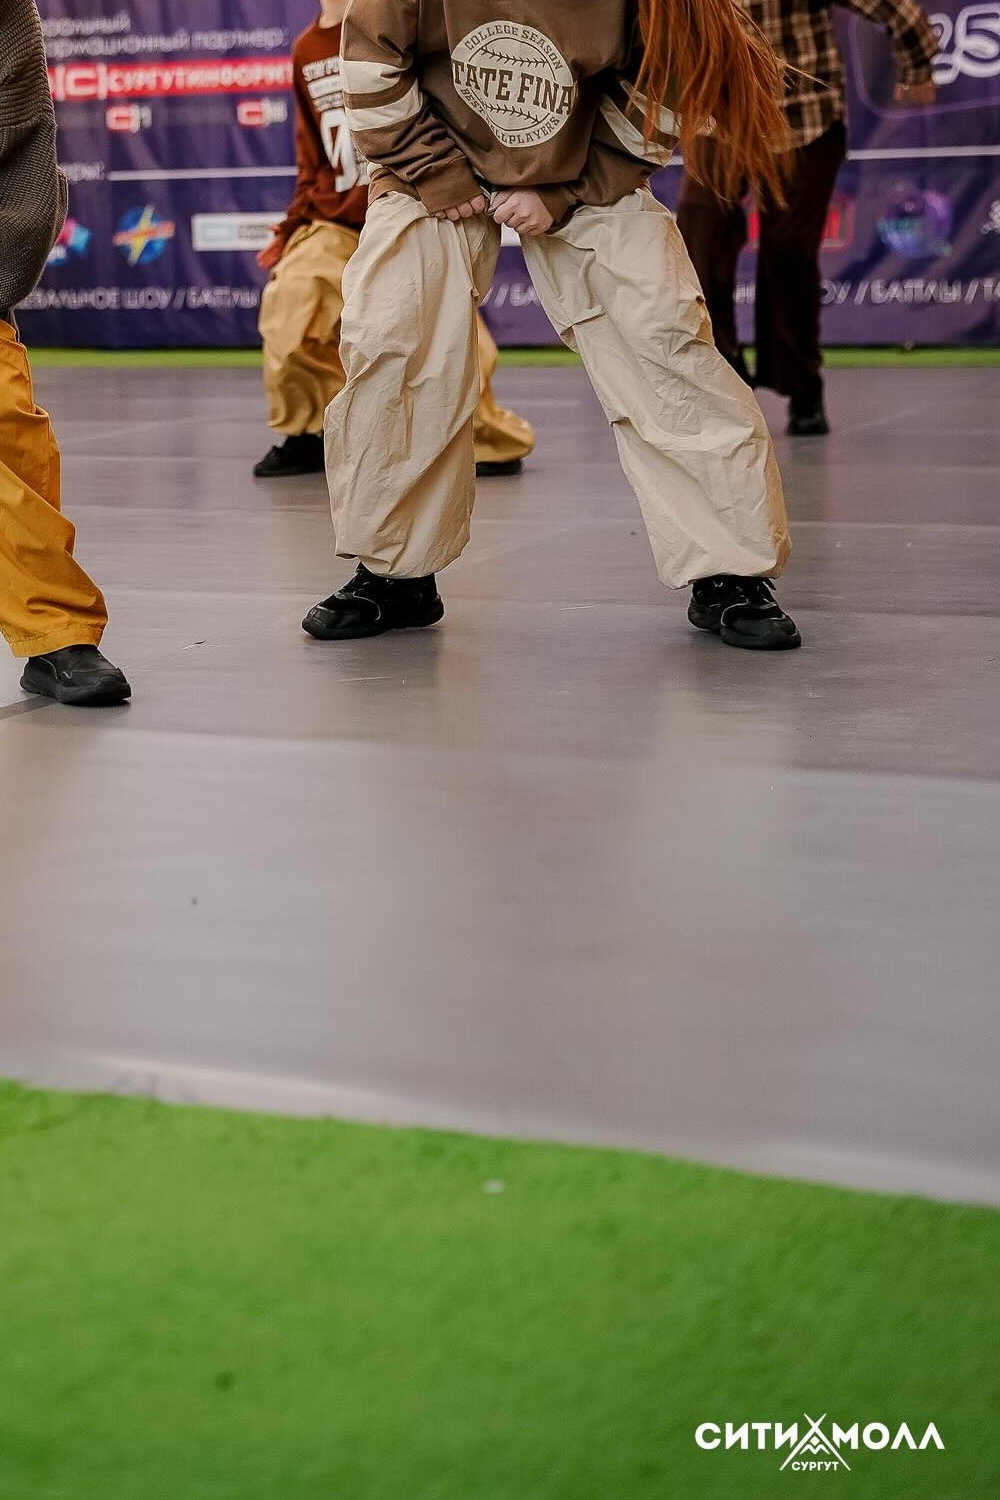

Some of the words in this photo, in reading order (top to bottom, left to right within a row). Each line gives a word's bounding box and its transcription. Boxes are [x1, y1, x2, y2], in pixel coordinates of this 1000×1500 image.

[464, 24, 519, 51] COLLEGE
[521, 30, 564, 70] SEASON
[452, 59, 513, 101] TATE
[517, 72, 576, 116] FINA
[460, 87, 485, 114] BEST
